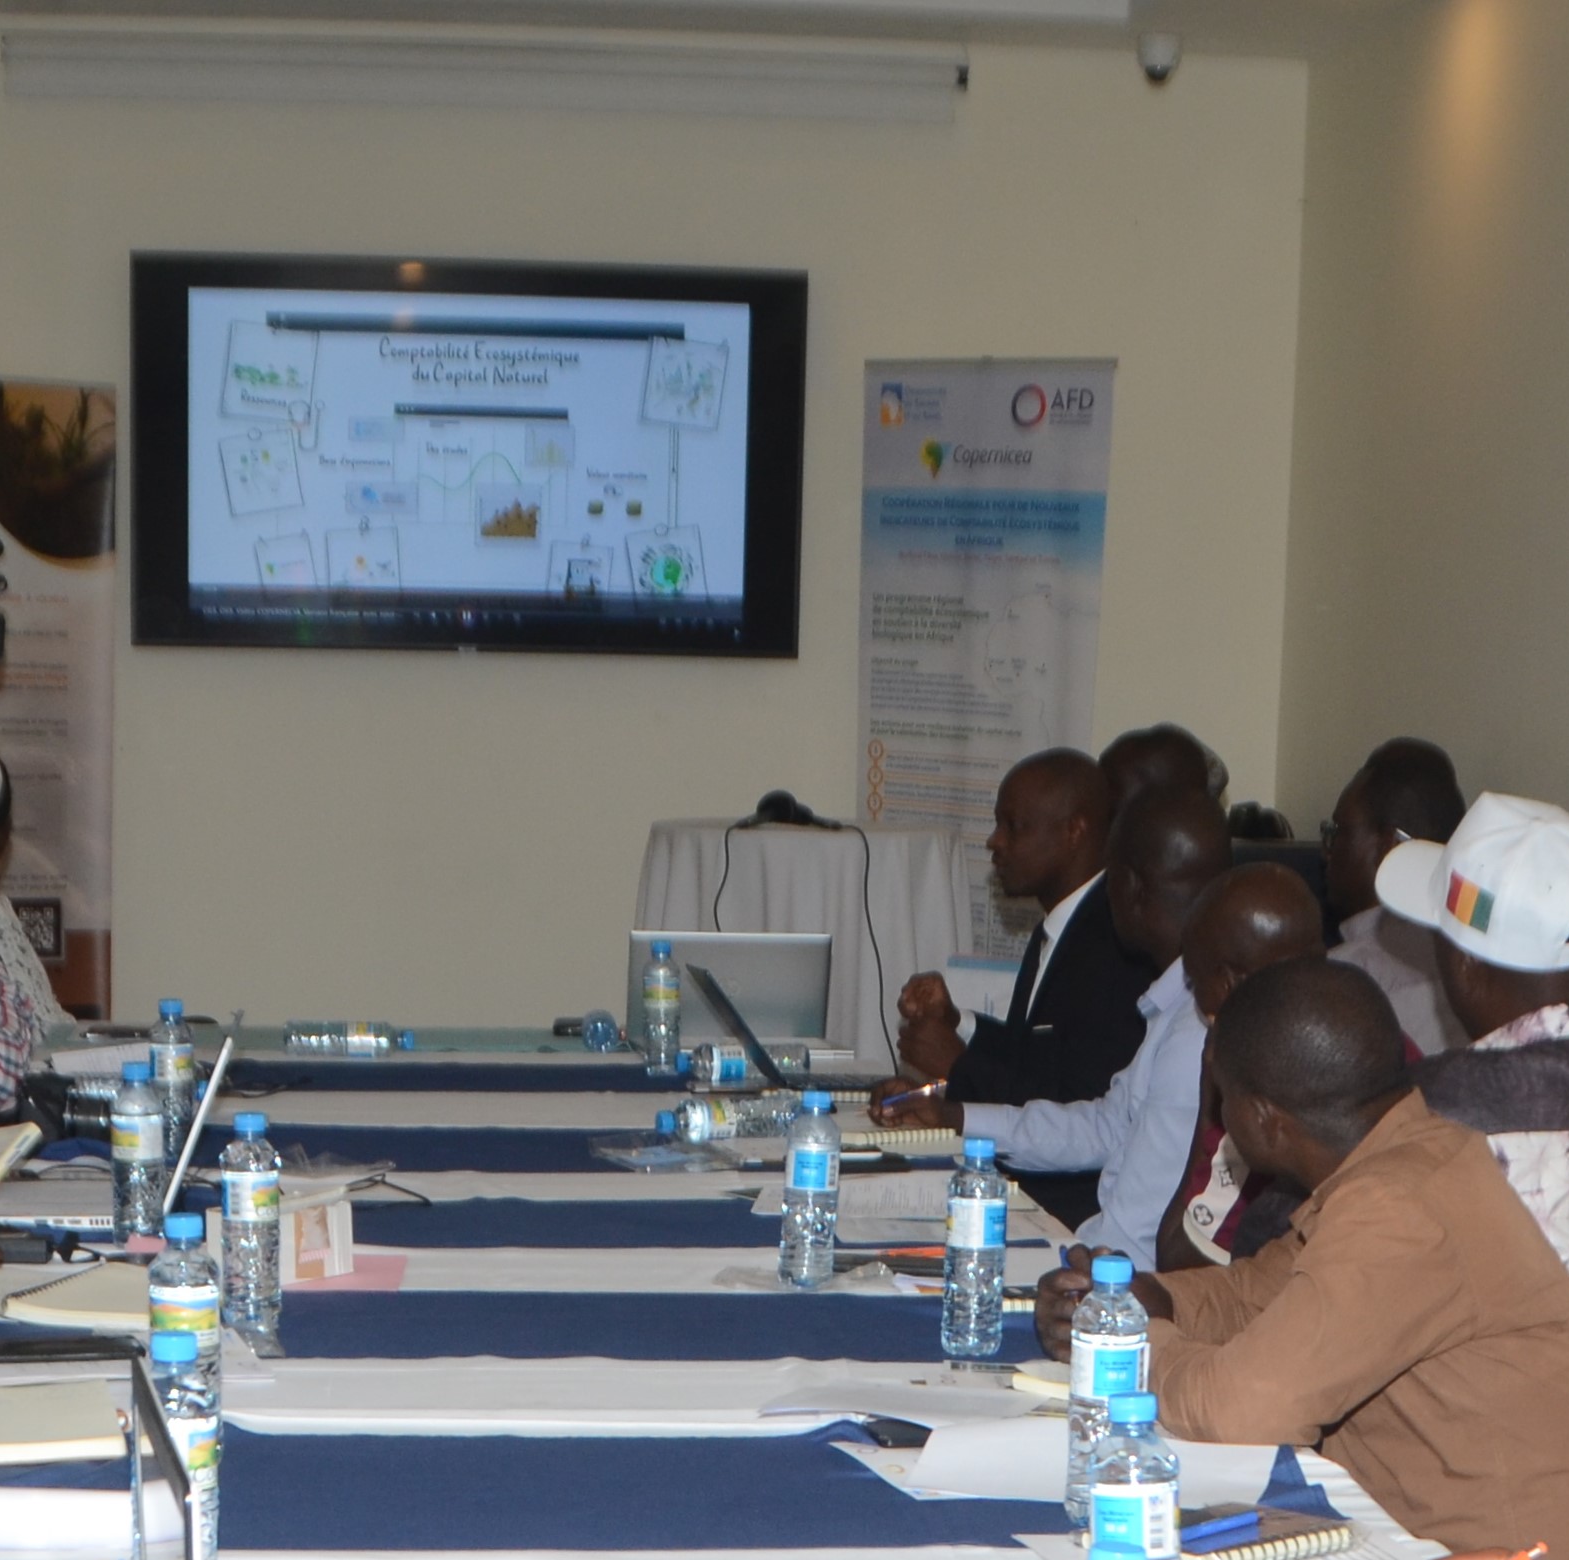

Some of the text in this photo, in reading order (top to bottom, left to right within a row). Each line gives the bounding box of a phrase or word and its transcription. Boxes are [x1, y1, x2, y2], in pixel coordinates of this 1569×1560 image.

[378, 336, 580, 367] Comptabilité Ecosystémique
[412, 361, 548, 387] du Capital Naturel
[1050, 387, 1095, 410] AFD
[953, 443, 1032, 468] Copernicea
